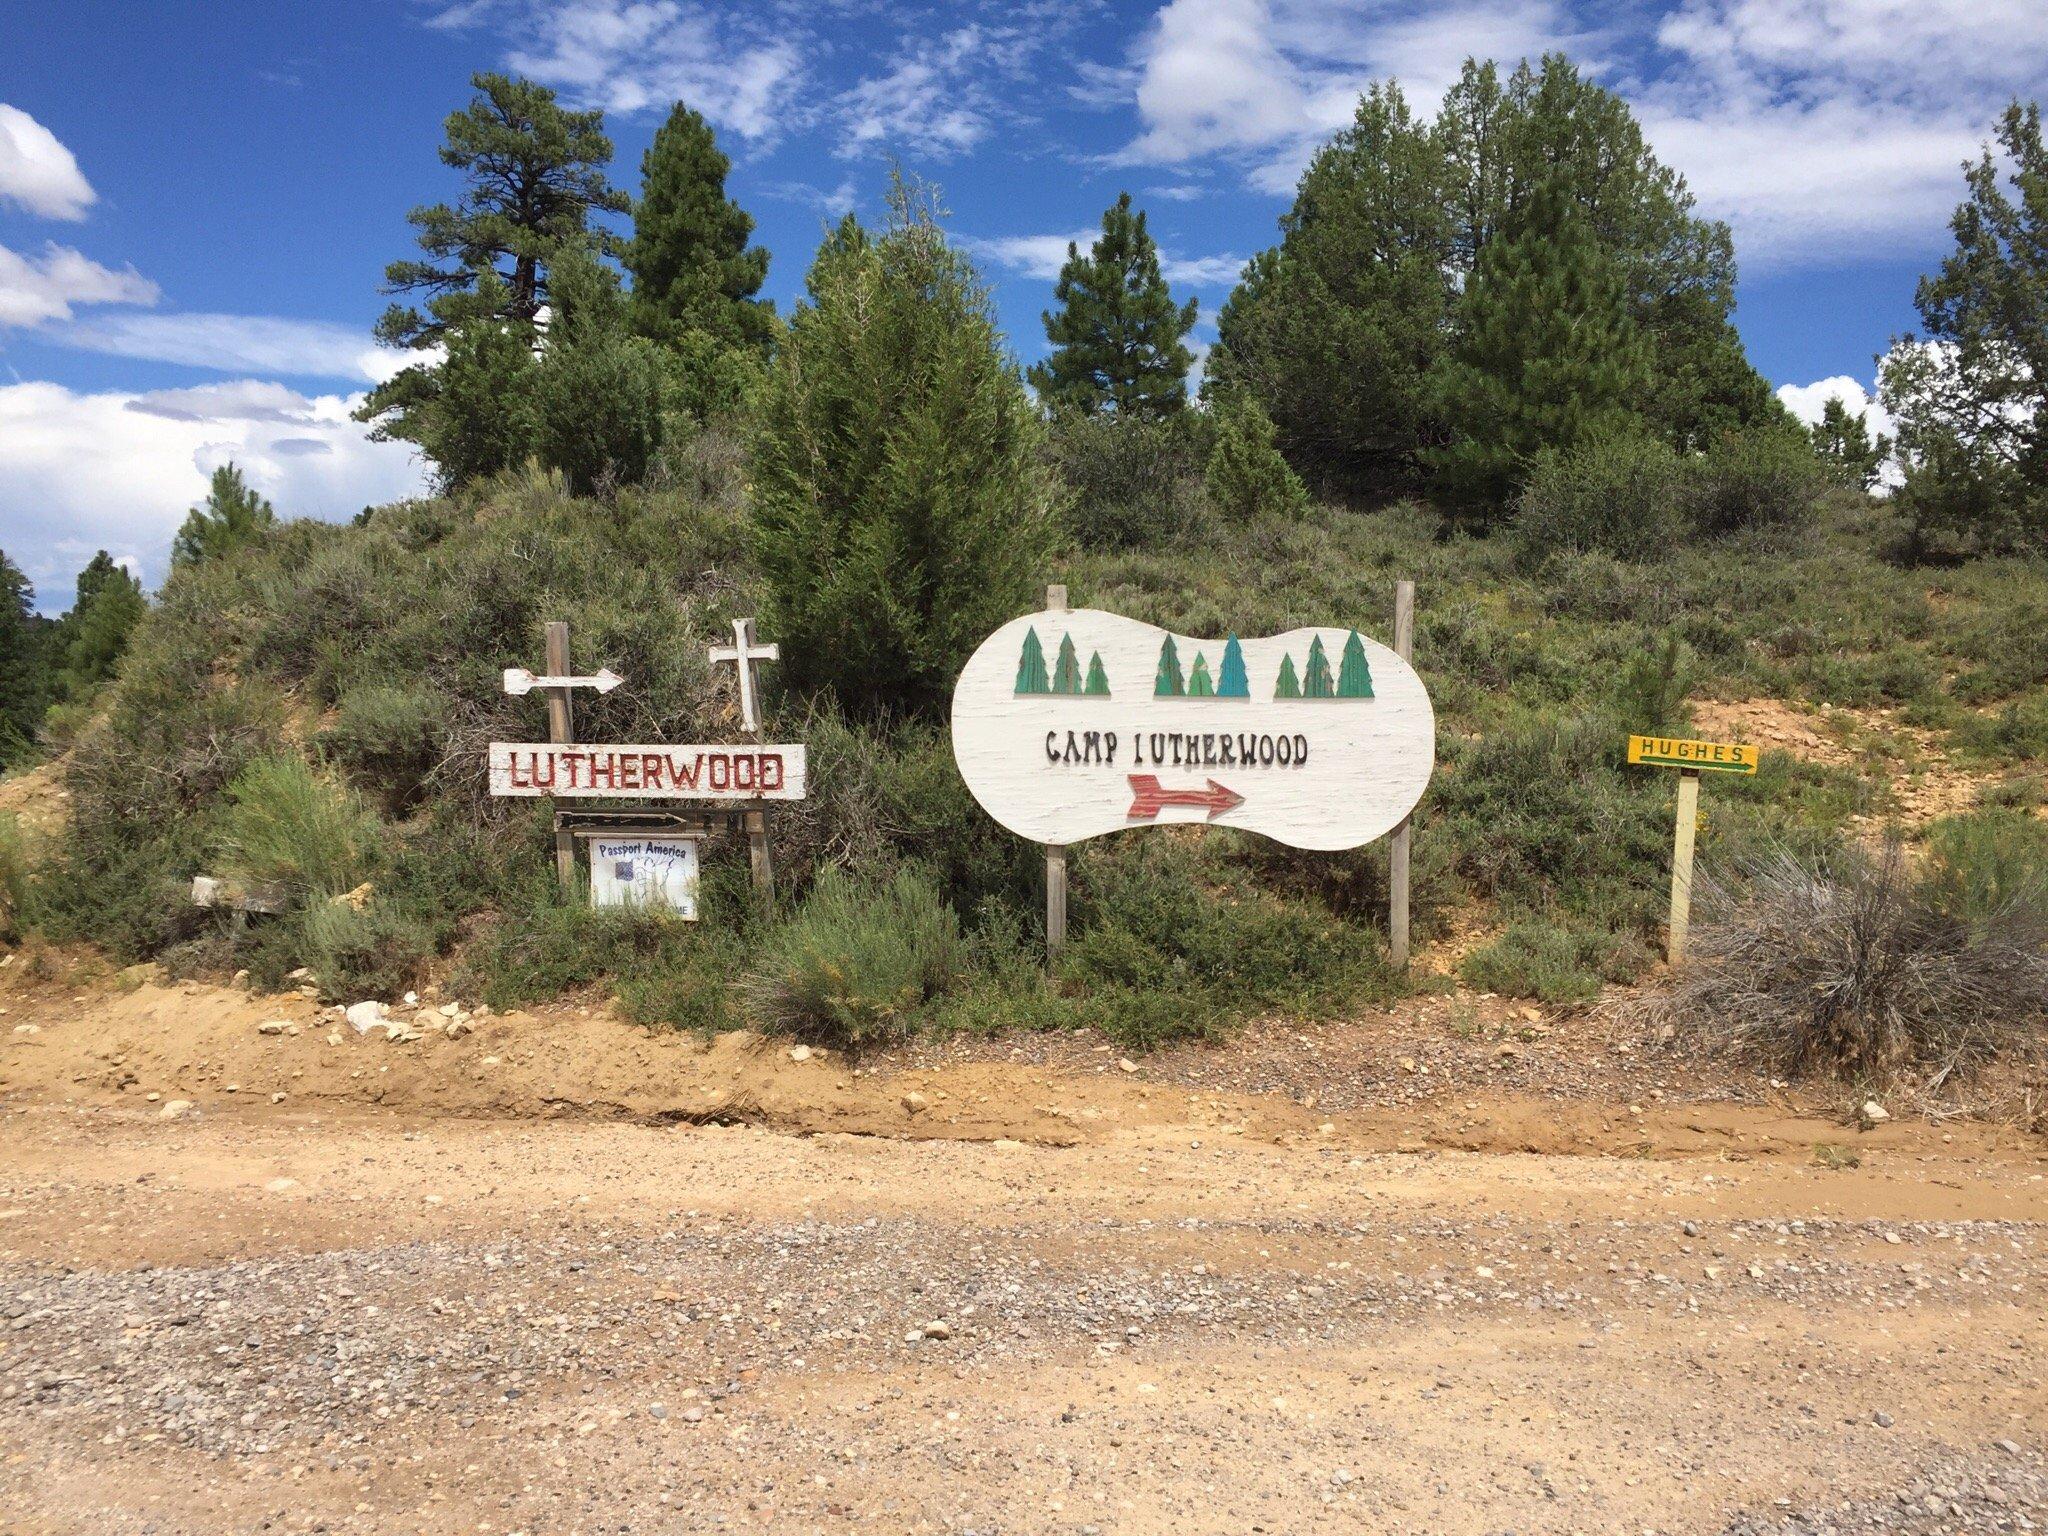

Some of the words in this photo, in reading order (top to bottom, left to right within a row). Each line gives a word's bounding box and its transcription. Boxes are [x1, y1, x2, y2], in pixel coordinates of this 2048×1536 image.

[1046, 730, 1117, 763] CAMP
[1642, 738, 1743, 762] HUGHES
[510, 751, 784, 791] LUTHERWOOD
[599, 843, 642, 857] Passport
[645, 841, 687, 859] America
